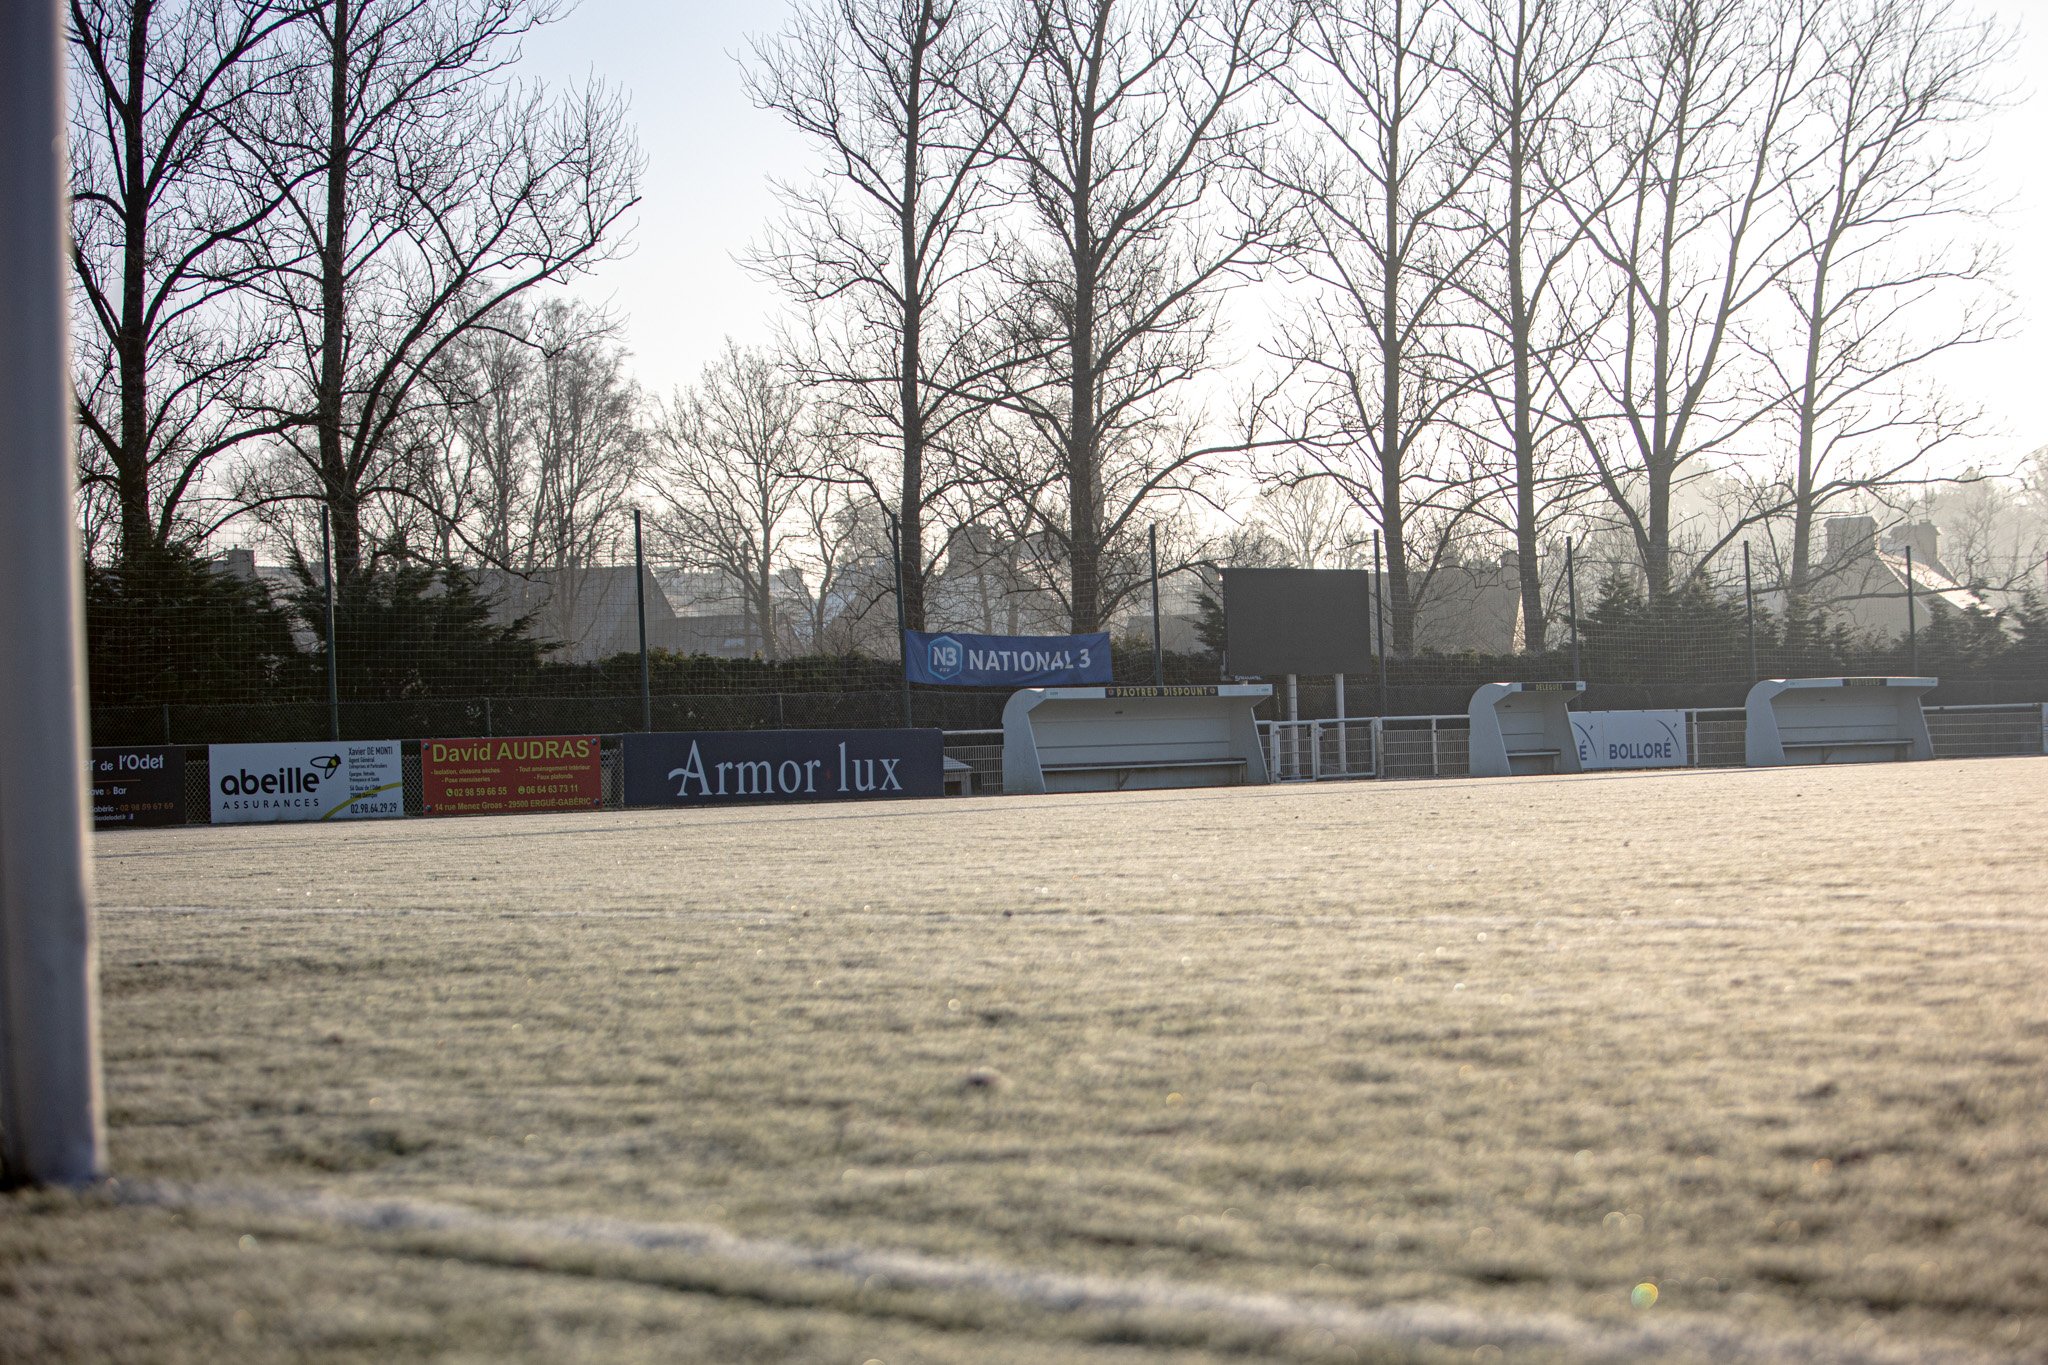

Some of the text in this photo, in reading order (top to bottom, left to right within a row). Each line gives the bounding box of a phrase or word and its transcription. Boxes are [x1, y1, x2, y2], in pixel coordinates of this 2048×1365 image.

[933, 646, 957, 666] N3
[968, 648, 1091, 672] NATIONAL 3
[1116, 687, 1208, 697] PAOTRED DISPOUNT
[348, 746, 393, 756] Xavier DE MONTI
[432, 740, 590, 763] David AUDRAS
[1609, 737, 1672, 760] BOLLORÉ
[100, 760, 114, 771] de
[119, 753, 164, 771] l'Odet
[668, 739, 903, 797] Armor lux
[220, 767, 320, 796] abeille
[526, 784, 578, 794] 06 64 63 73 11
[113, 786, 127, 795] Bar
[454, 786, 507, 797] 02 98 59 66 55
[222, 798, 319, 810] ASSURANCES
[481, 801, 503, 809] Groas
[508, 800, 529, 808] 29500
